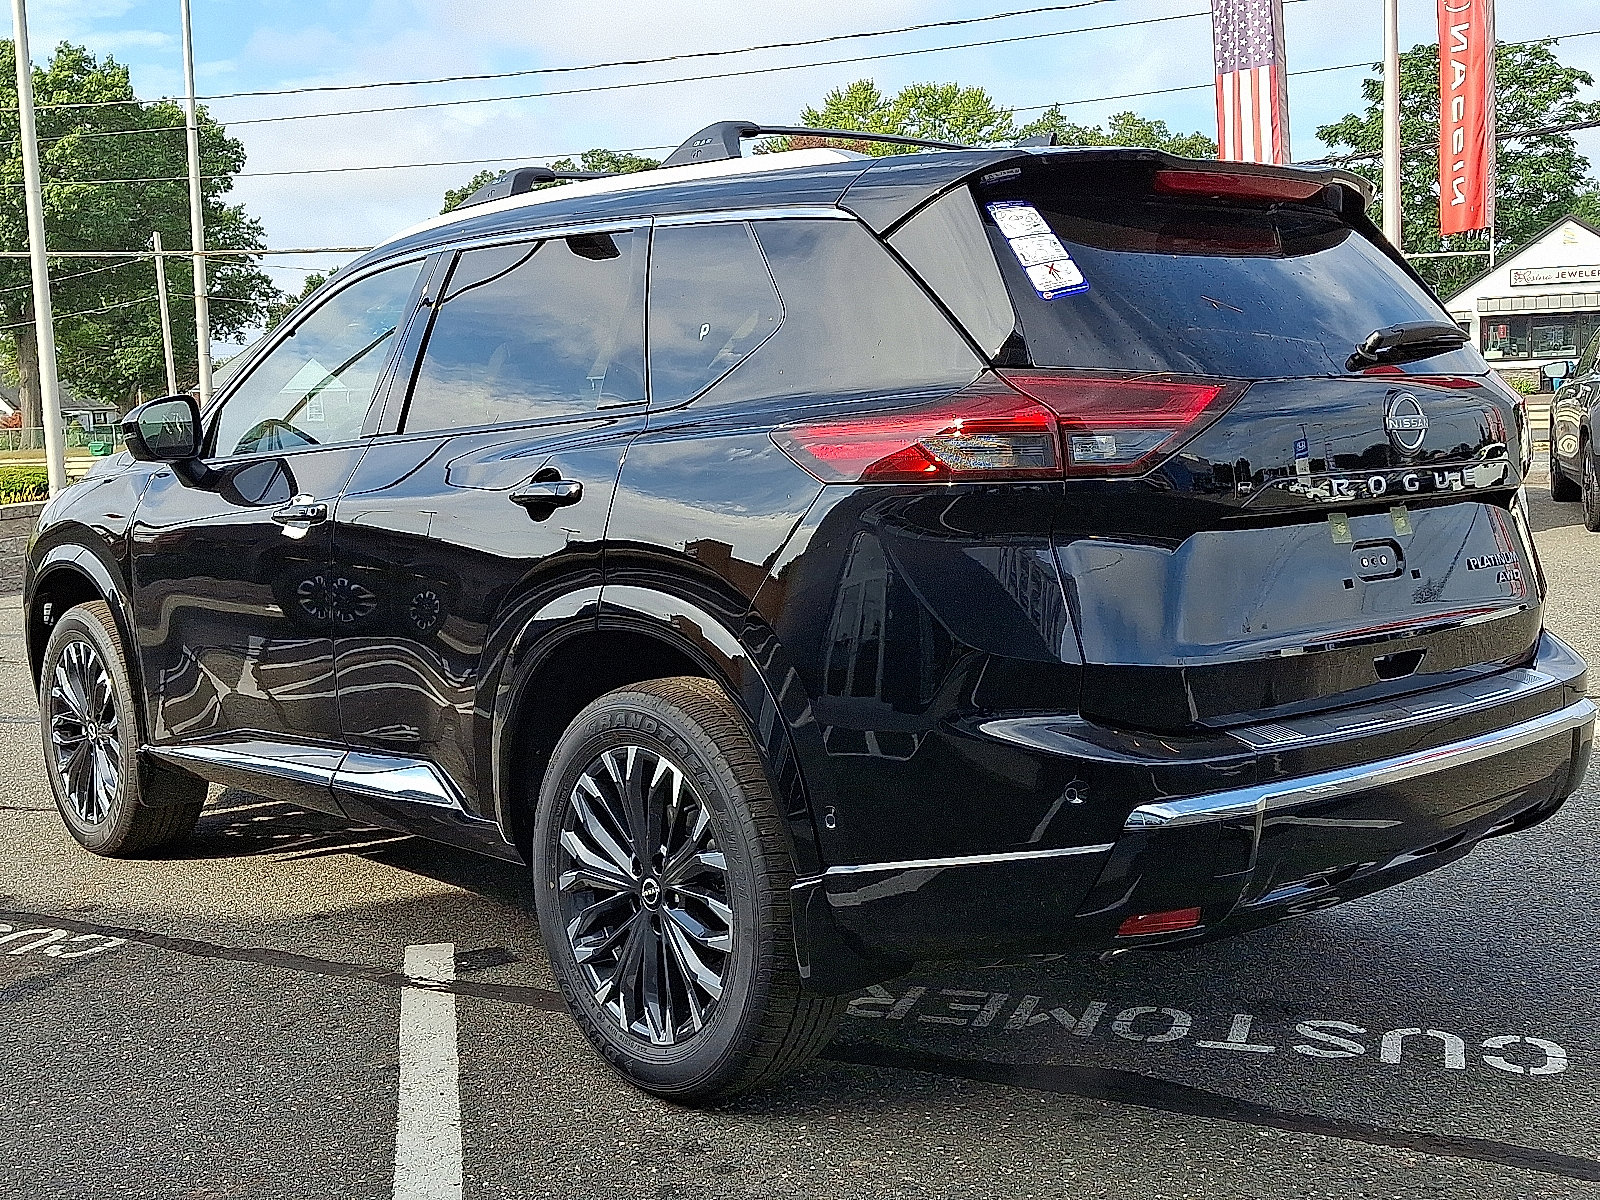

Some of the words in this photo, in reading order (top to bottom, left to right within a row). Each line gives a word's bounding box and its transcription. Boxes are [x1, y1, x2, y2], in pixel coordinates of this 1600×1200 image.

[1387, 414, 1430, 430] NISSAN
[1330, 470, 1476, 497] ROGUE
[1468, 551, 1519, 571] PLATINUM
[1498, 568, 1521, 582] AWD
[584, 711, 717, 796] GRANDTREK
[0, 924, 128, 959] CU
[845, 983, 1569, 1076] CUSTOMER
